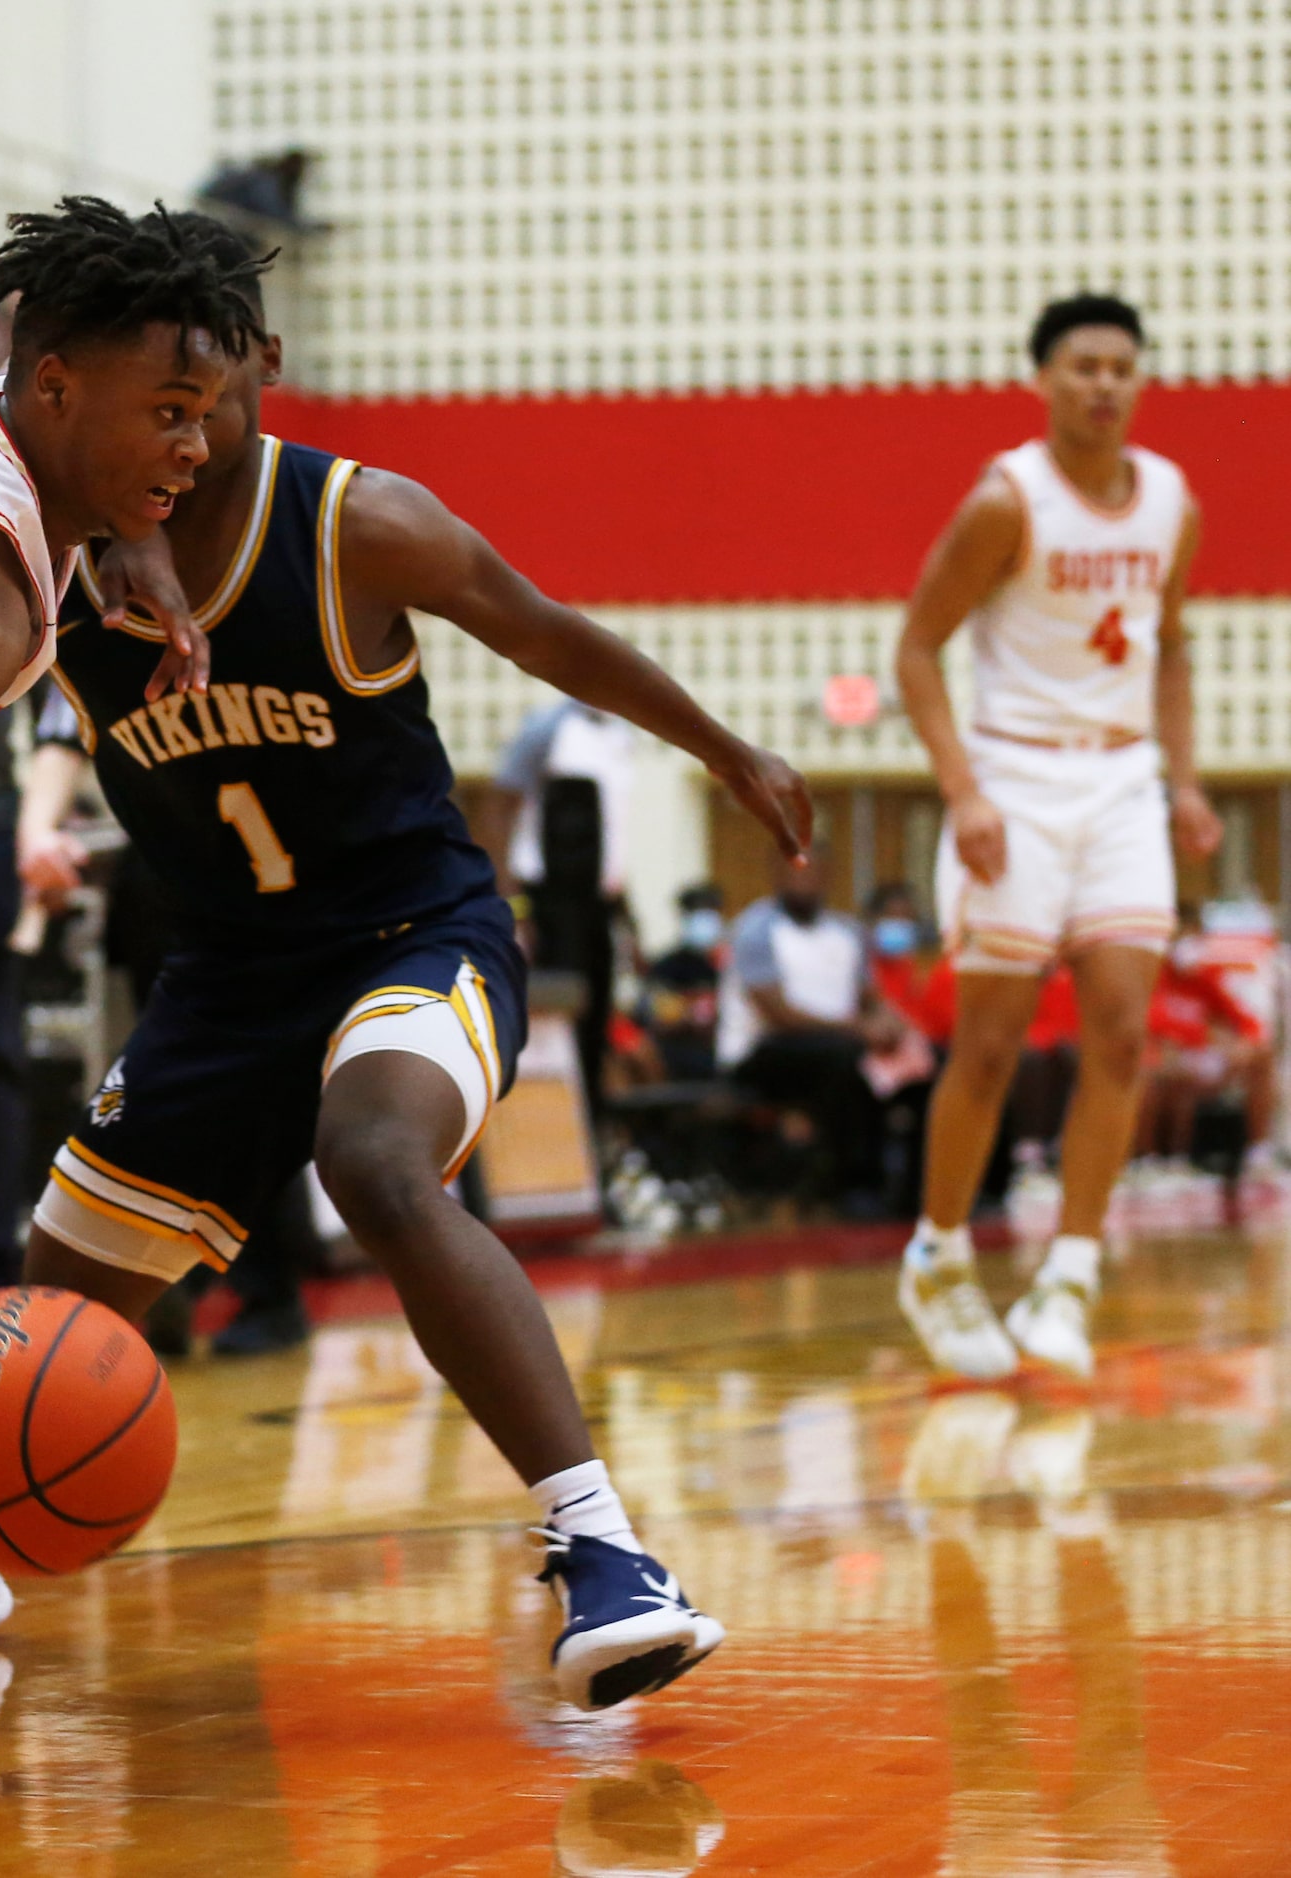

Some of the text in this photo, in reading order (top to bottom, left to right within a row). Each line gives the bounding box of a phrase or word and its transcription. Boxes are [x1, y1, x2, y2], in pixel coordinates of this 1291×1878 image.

[1086, 604, 1130, 666] 4
[109, 683, 337, 770] VIKINGS
[217, 781, 296, 893] 1
